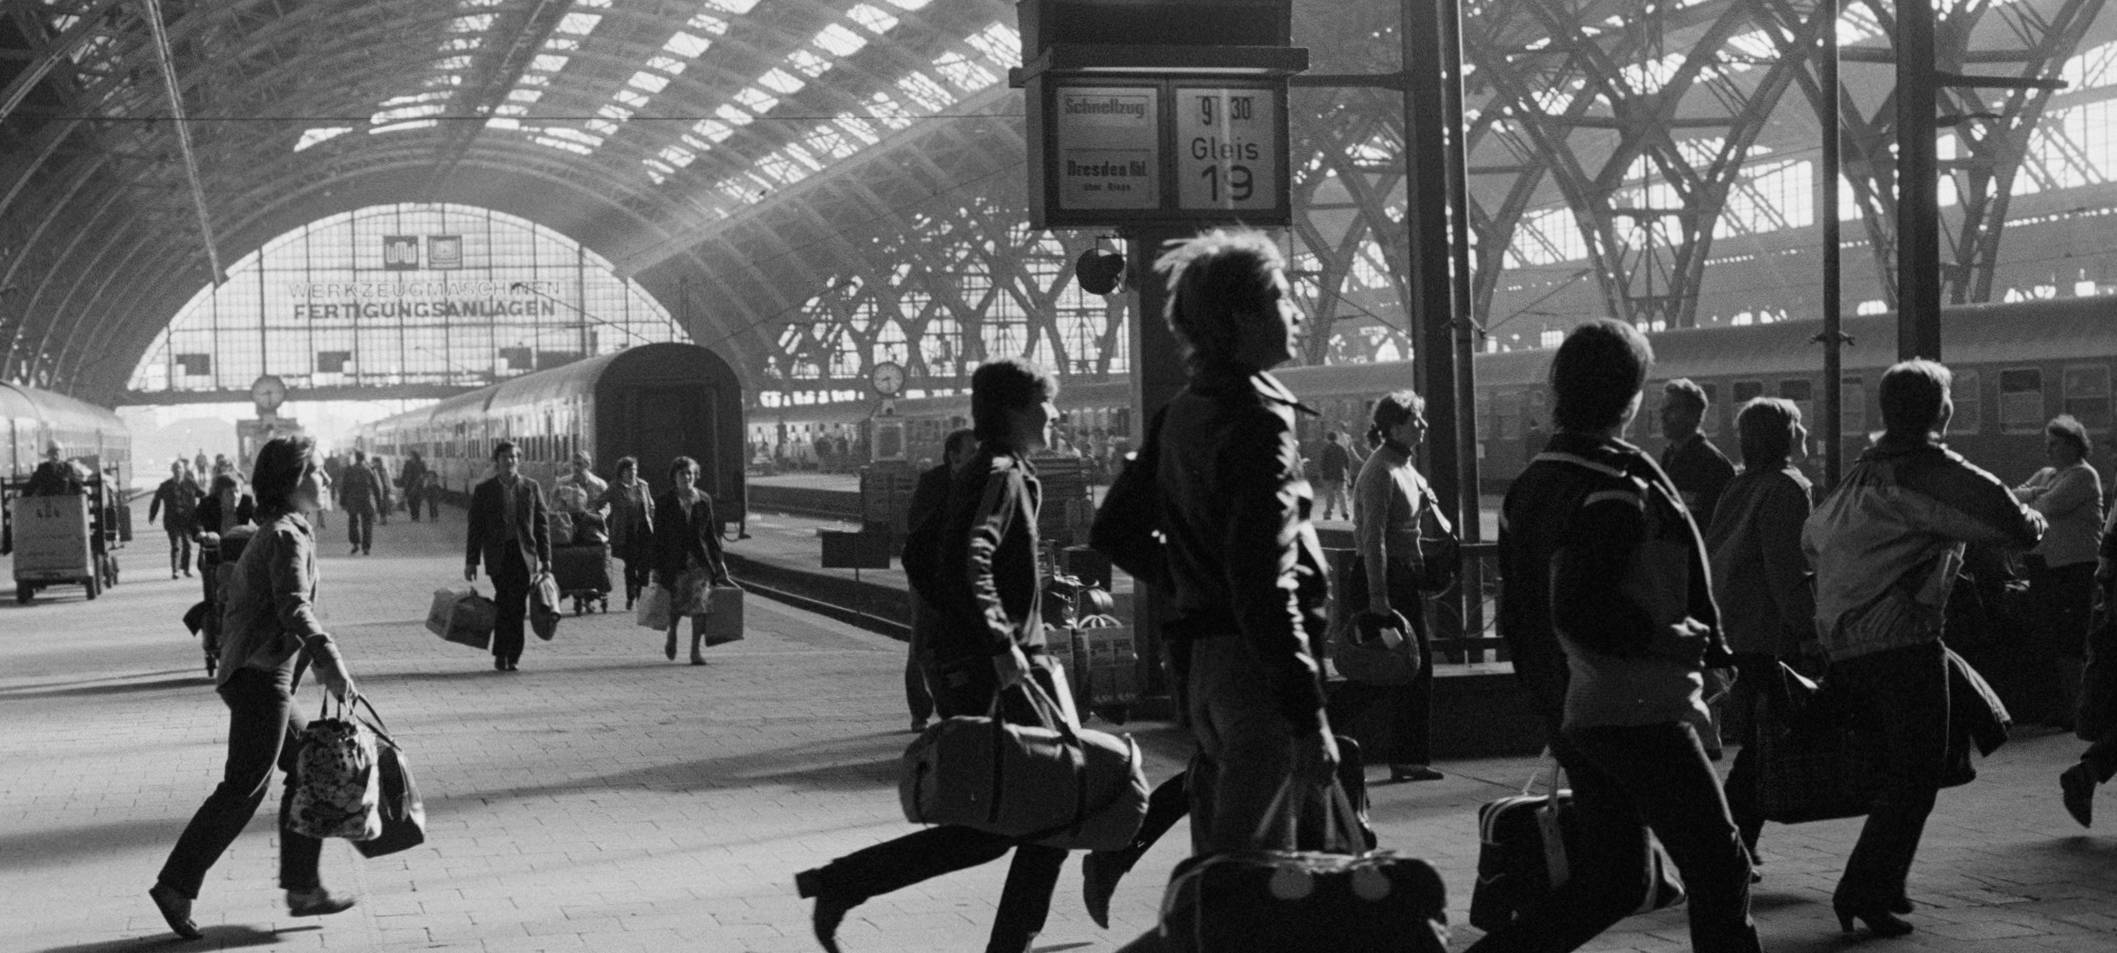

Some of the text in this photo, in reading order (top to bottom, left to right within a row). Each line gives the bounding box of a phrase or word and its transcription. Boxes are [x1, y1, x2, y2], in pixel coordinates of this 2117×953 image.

[1064, 98, 1144, 118] Schnellzug
[1230, 97, 1251, 120] 30
[1191, 137, 1259, 160] Gleis
[1067, 161, 1127, 177] Dresden
[1201, 164, 1254, 202] 19
[289, 281, 560, 300] WERKZEUGMASCHINEN
[294, 301, 556, 319] FERTIGUNGSANLAGEN
